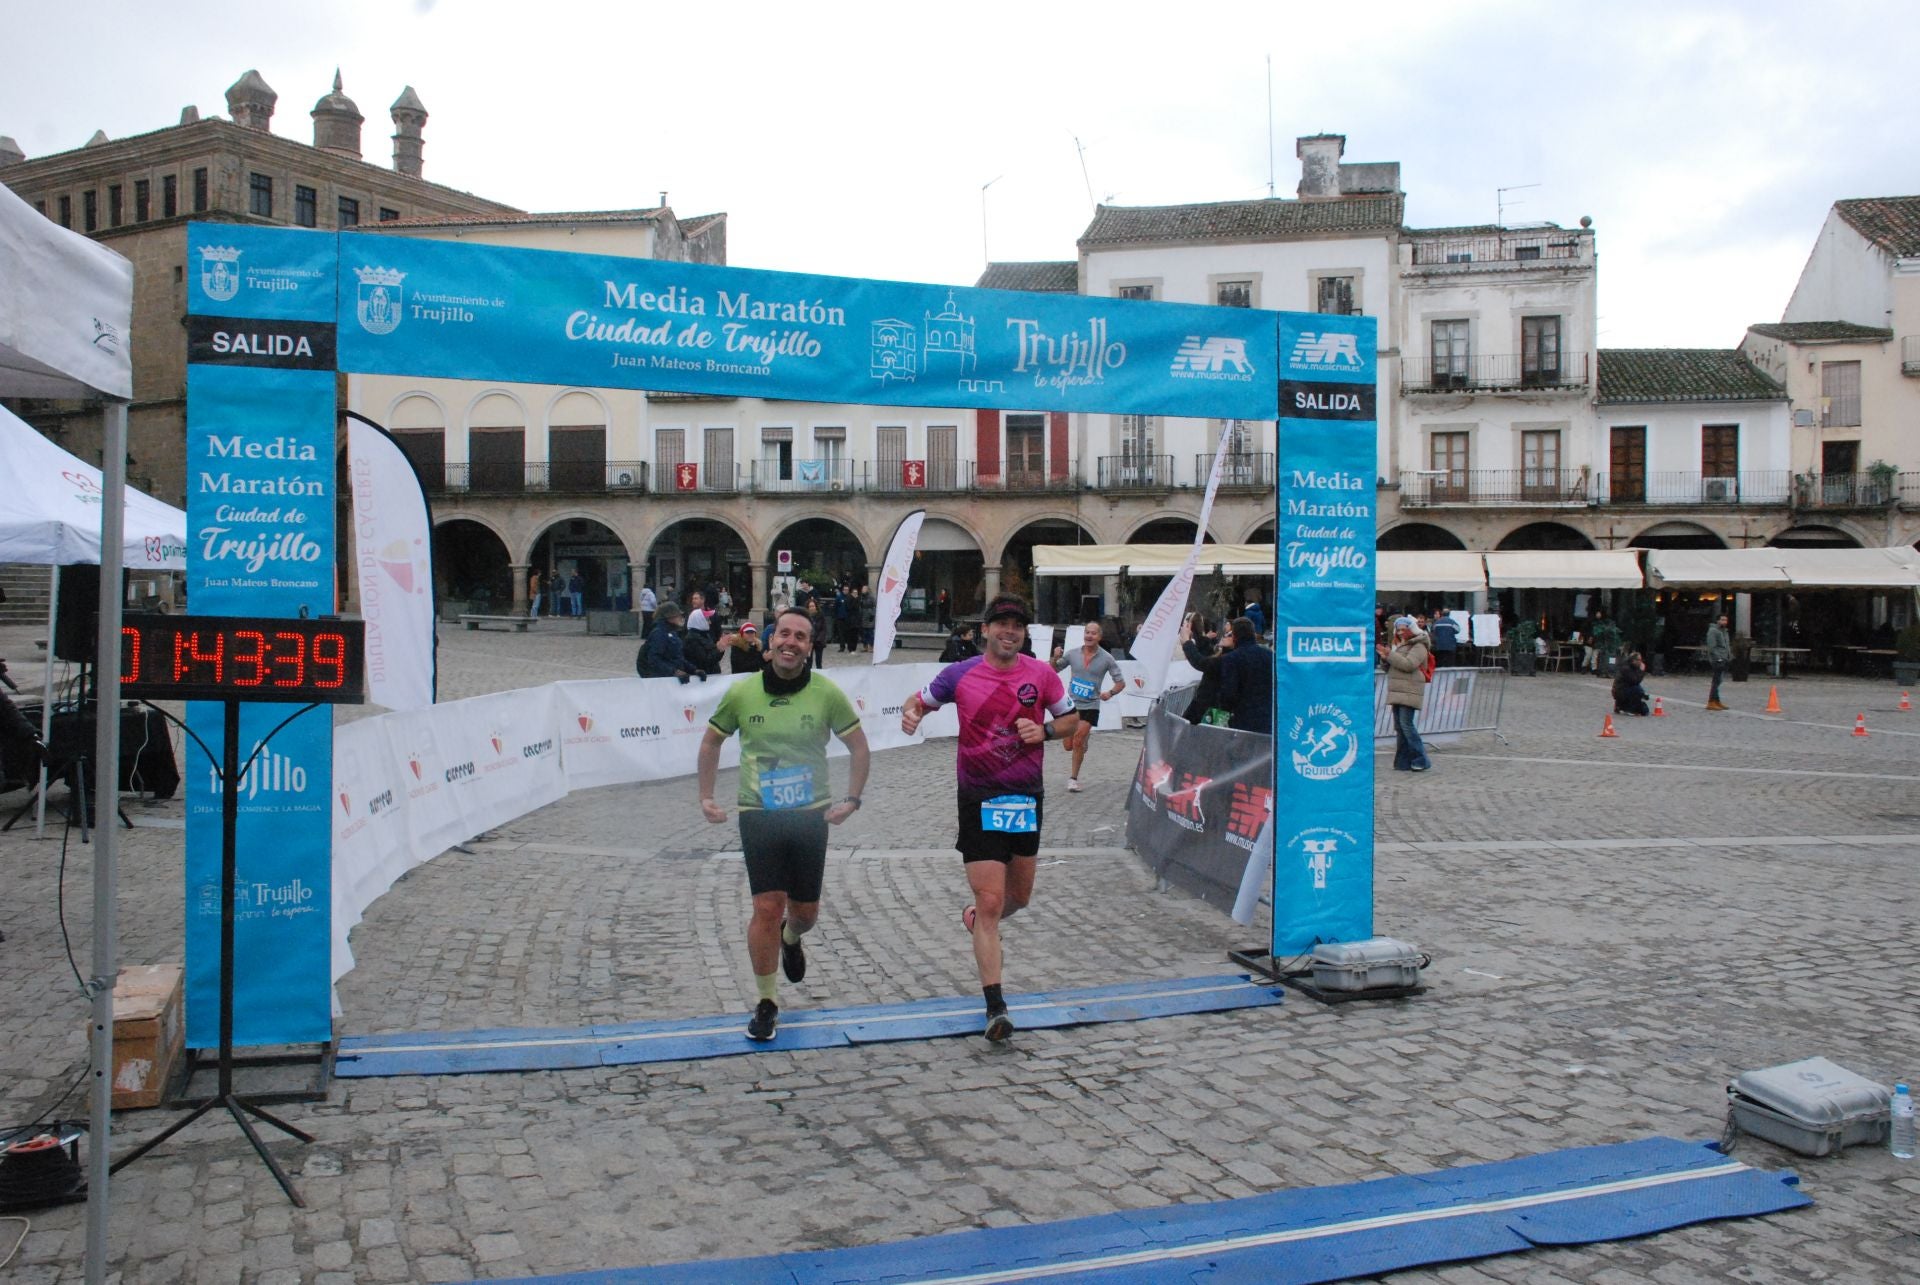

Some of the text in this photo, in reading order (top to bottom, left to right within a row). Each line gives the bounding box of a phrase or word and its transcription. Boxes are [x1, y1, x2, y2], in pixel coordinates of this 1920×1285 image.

[247, 266, 324, 279] Ayuntamiento de
[246, 277, 298, 292] Trujillo
[411, 292, 505, 307] Ayuntamiento de
[604, 281, 846, 327] Media Maratón
[411, 305, 474, 326] Trujillo
[212, 332, 312, 357] SALIDA
[565, 311, 822, 364] Ciudad de Trujillo
[1006, 317, 1126, 379] Trujillo
[612, 352, 770, 376] Juan Mateos Broncano
[1289, 361, 1361, 373] www.musicrun.es
[1035, 368, 1048, 387] te
[1170, 369, 1252, 382] www.musicrun.es
[1296, 392, 1361, 411] SALIDA
[207, 435, 316, 460] Media
[200, 472, 325, 496] Maratón
[1291, 470, 1363, 490] Media
[216, 504, 307, 523] Ciudad de
[1288, 499, 1369, 518] Maratón
[1296, 524, 1355, 540] Ciudad de
[199, 527, 321, 573] Trujillo
[1287, 541, 1367, 577] Trujillo
[205, 577, 318, 588] Juan Mateos Broncano
[1299, 637, 1354, 652] HABLA
[1290, 703, 1352, 740] Club Atletismo
[1297, 762, 1343, 775] TRUJILLO
[992, 810, 1026, 829] 574
[252, 879, 312, 905] Trujillo
